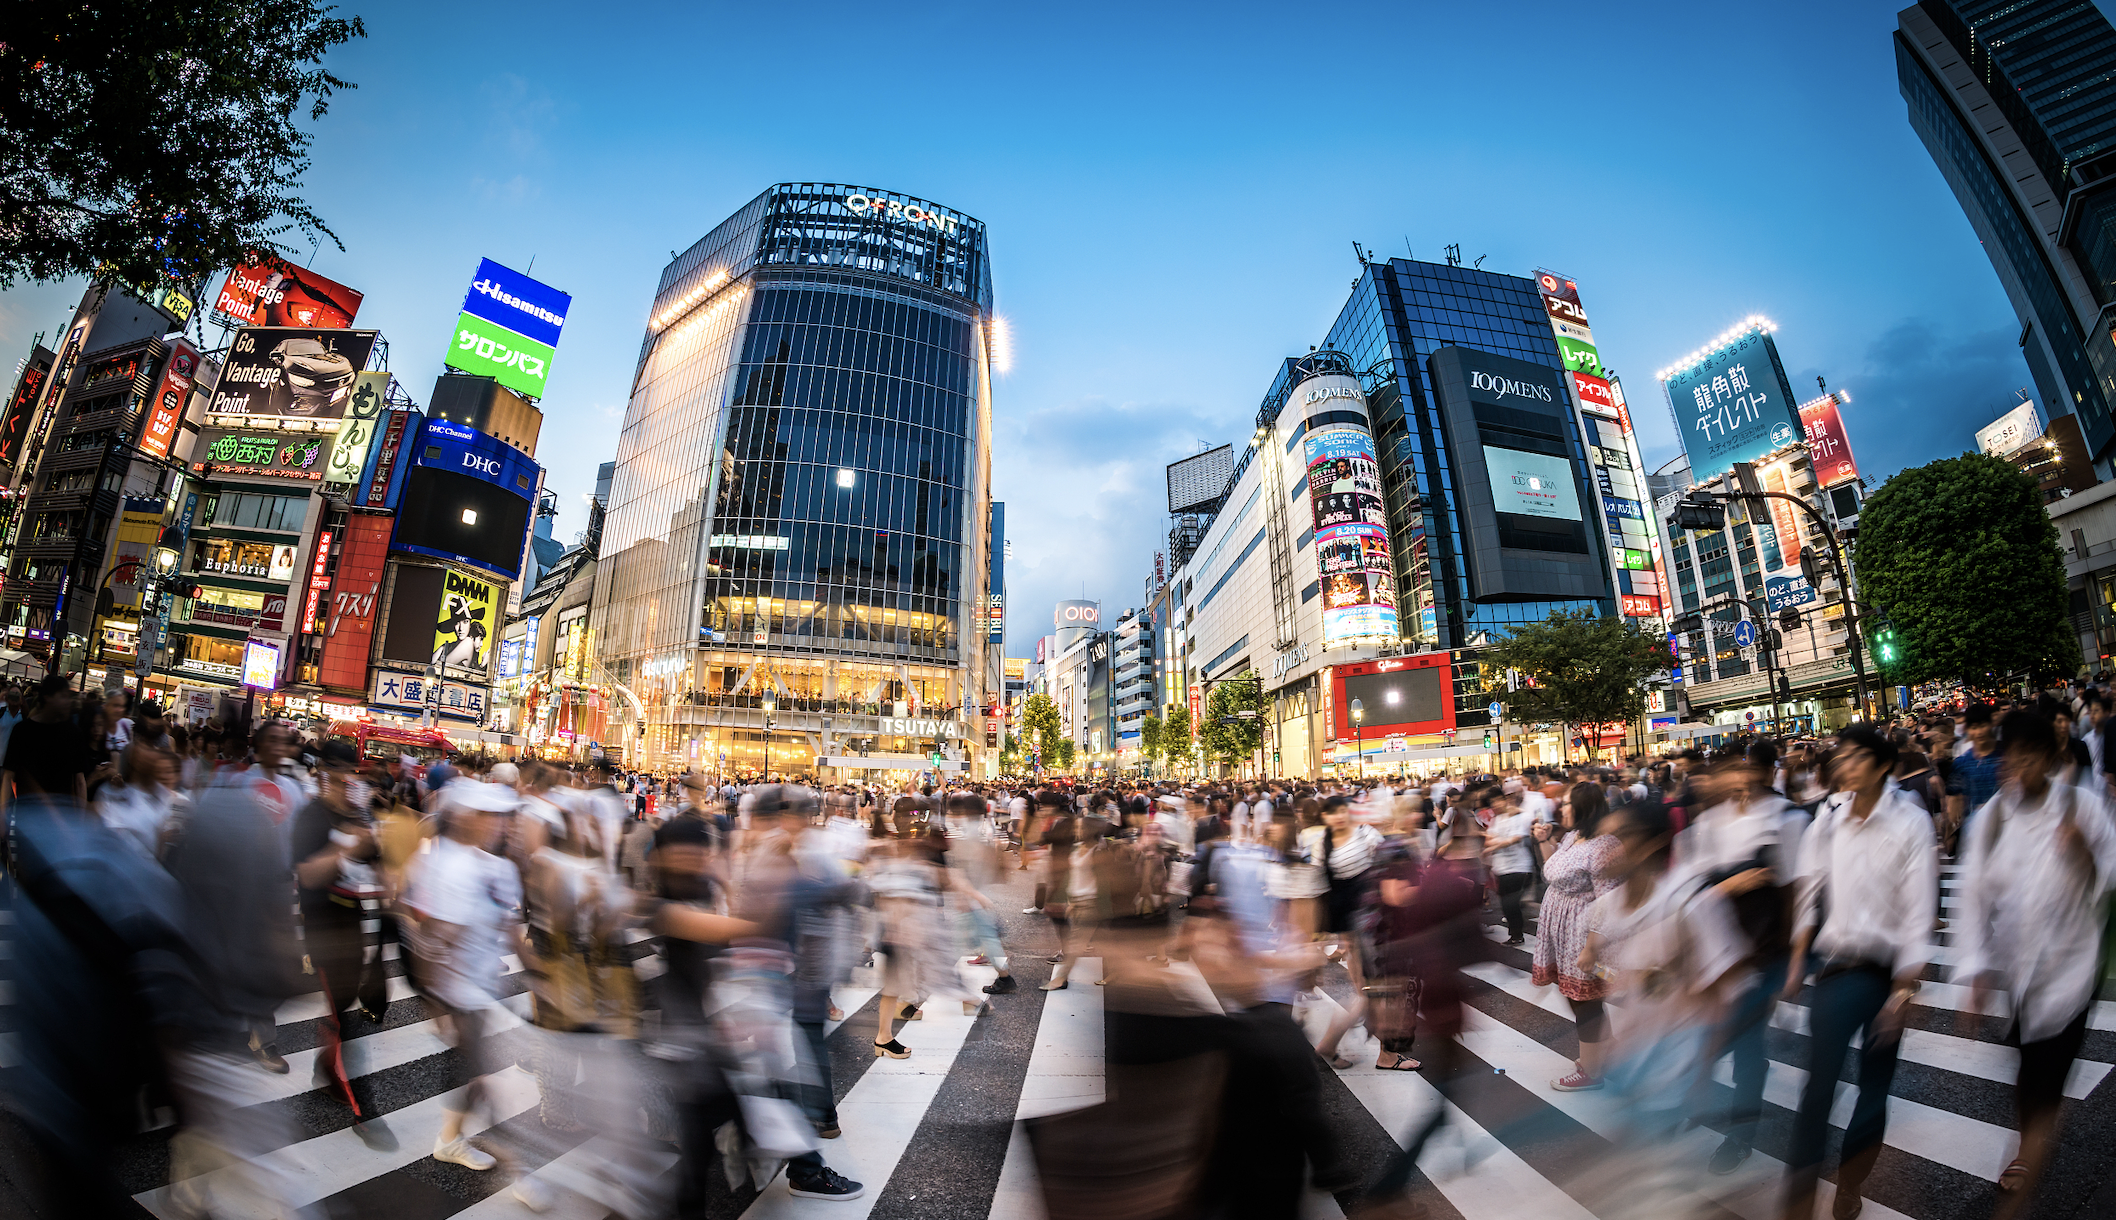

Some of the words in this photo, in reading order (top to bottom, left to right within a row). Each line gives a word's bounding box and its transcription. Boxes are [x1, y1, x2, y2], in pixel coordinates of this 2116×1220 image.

[230, 269, 285, 305] Vantage
[217, 291, 256, 321] Point.
[473, 278, 565, 328] Hisamitsu
[1548, 296, 1588, 320] アコム
[235, 332, 256, 354] Go,
[458, 329, 545, 380] サロンパス
[1562, 345, 1597, 367] レイク
[1669, 333, 1758, 390] のど、直接、うるおう
[27, 372, 42, 399] TOKYO
[225, 361, 282, 388] Vantage
[1576, 378, 1612, 400] アイフル
[1692, 363, 1751, 413] 龍角散
[211, 391, 251, 414] Point.
[1695, 391, 1767, 442] ダイレクト
[332, 382, 380, 480] もんじゃ
[428, 424, 447, 436] DHC
[445, 428, 473, 440] Channel
[1318, 433, 1363, 443] SUMMER
[1772, 426, 1791, 444] 生薬
[1986, 423, 2018, 447] TOSEI
[236, 444, 276, 465] 西村
[1324, 439, 1360, 448] SONIC
[1327, 449, 1346, 458] 8.19
[367, 413, 405, 502] 三千里薬品
[461, 452, 501, 476] DHC
[1336, 526, 1357, 536] 8.20
[1357, 527, 1373, 535] SUN
[204, 557, 267, 577] Euphoria
[1155, 552, 1165, 583] 大和証券
[1626, 554, 1642, 565] レイク
[446, 571, 490, 605] DMM
[1657, 571, 1668, 593] アコム
[263, 599, 286, 614] JTB
[441, 593, 474, 620] FX
[1625, 600, 1651, 612] アコム
[1775, 592, 1809, 609] うるおう
[991, 594, 1003, 635] SEIBU
[136, 622, 154, 670] 道玄坂
[1089, 641, 1108, 664] ZARA
[882, 718, 956, 737] TSUTAYA
